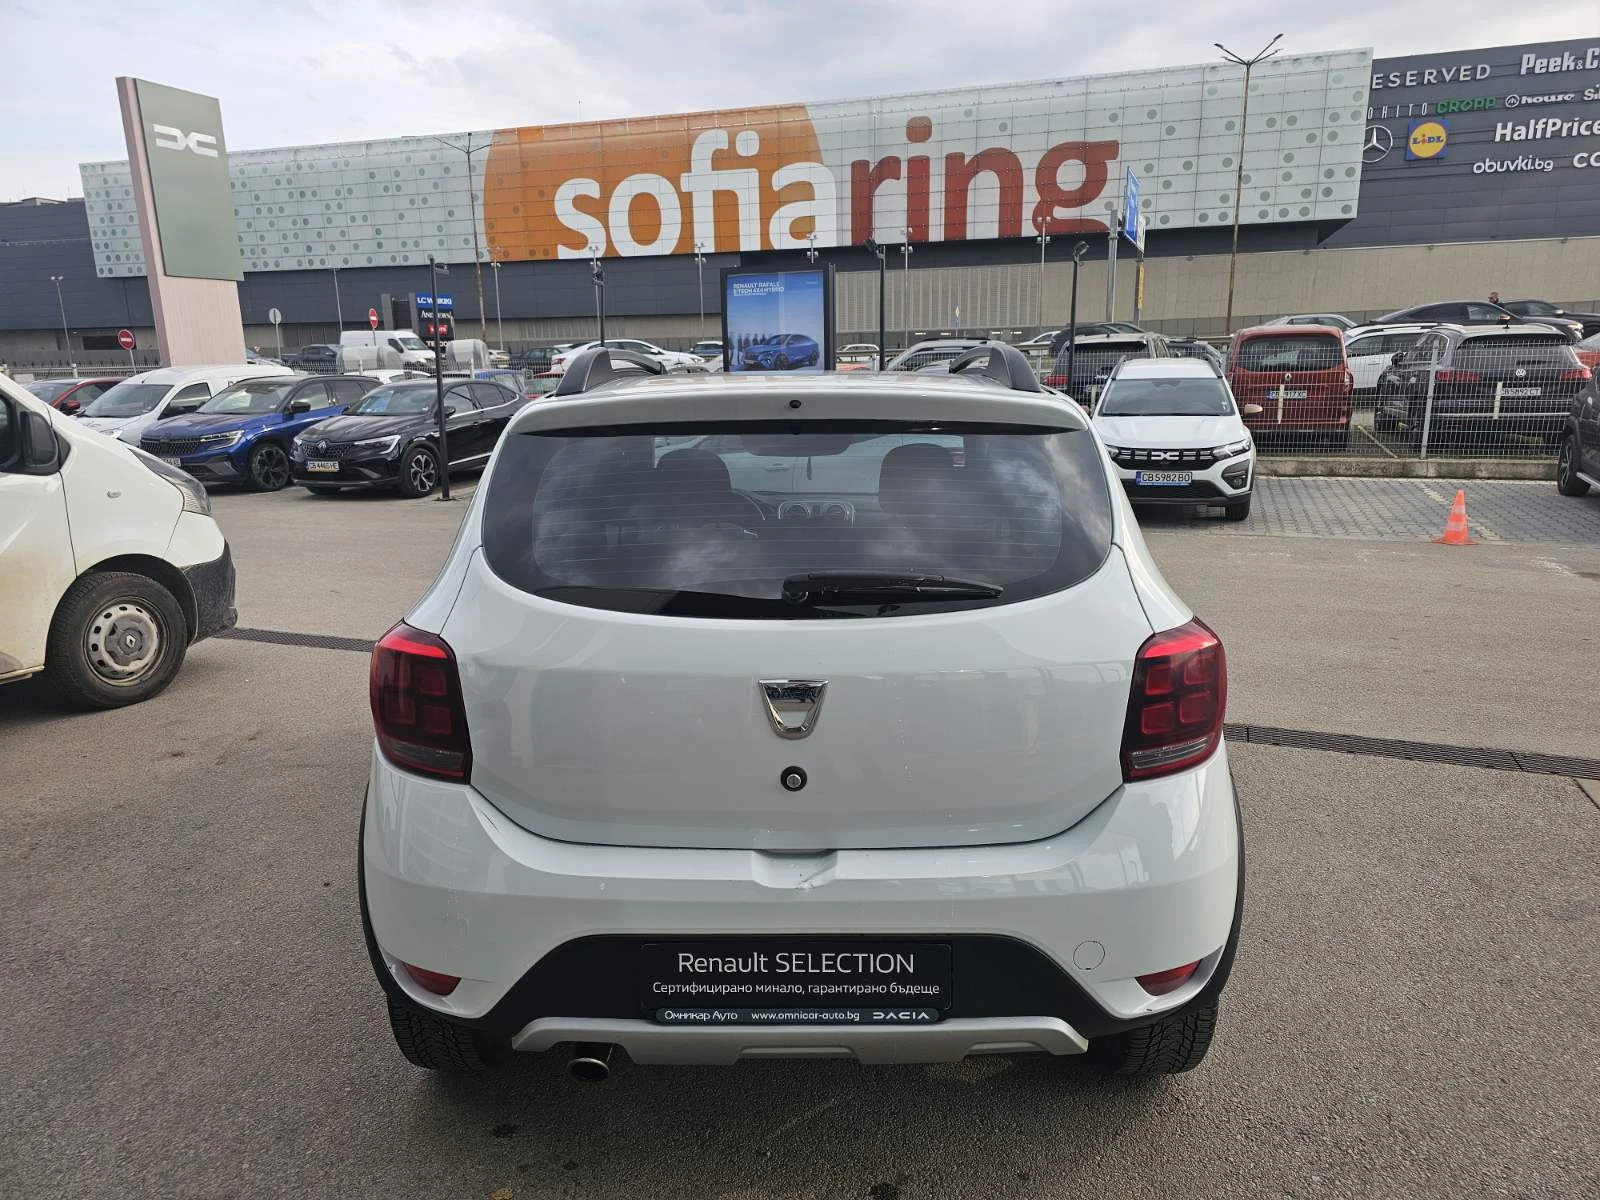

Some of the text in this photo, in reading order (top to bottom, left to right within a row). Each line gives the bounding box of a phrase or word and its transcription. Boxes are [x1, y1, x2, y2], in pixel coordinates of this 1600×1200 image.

[1437, 97, 1496, 113] CROPP
[1495, 117, 1600, 142] HalfPrice
[1473, 155, 1553, 173] obuvki.bg
[678, 952, 914, 973] Renault SELECTION
[652, 981, 940, 995] Сертифицирано минало, гарантирано бъдеще
[664, 1010, 738, 1021] Омникар Ауто
[751, 1011, 860, 1021] www.omnicar-auto.bg
